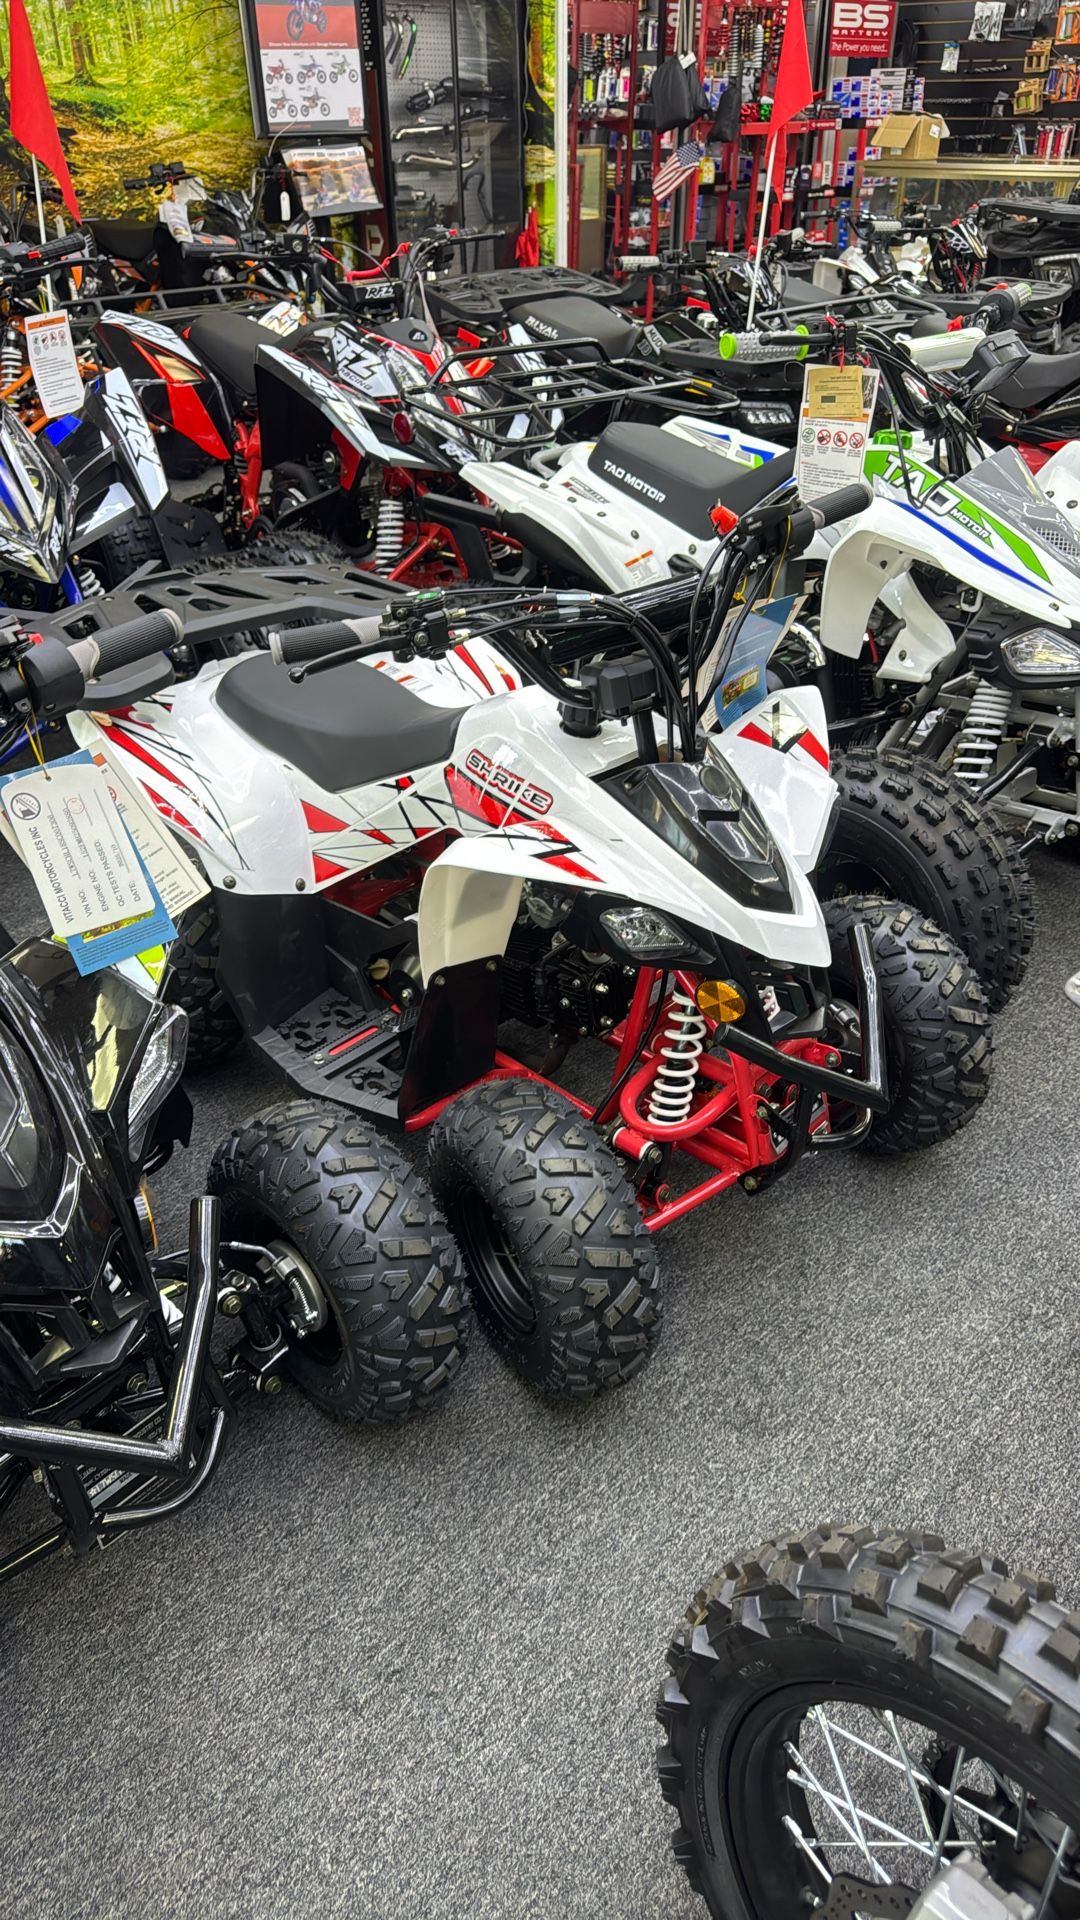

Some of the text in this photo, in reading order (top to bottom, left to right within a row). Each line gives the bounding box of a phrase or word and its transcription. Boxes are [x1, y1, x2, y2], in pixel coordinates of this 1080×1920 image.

[832, 2, 890, 29] BS
[832, 29, 888, 37] BATTERY
[831, 42, 841, 51] The
[843, 42, 859, 51] Power
[860, 45, 869, 53] you
[647, 327, 665, 351] MUD
[339, 367, 374, 391] RACING
[603, 460, 625, 479] TAO
[624, 473, 666, 503] MOTOR
[950, 508, 991, 539] MOTOR
[468, 754, 548, 808] SHRIKE
[28, 825, 74, 923] VITACCI MOTORCYCLES INC
[105, 870, 119, 893] TESTS
[91, 880, 109, 911] ENGINE
[114, 893, 125, 906] QC
[82, 903, 93, 917] VIN
